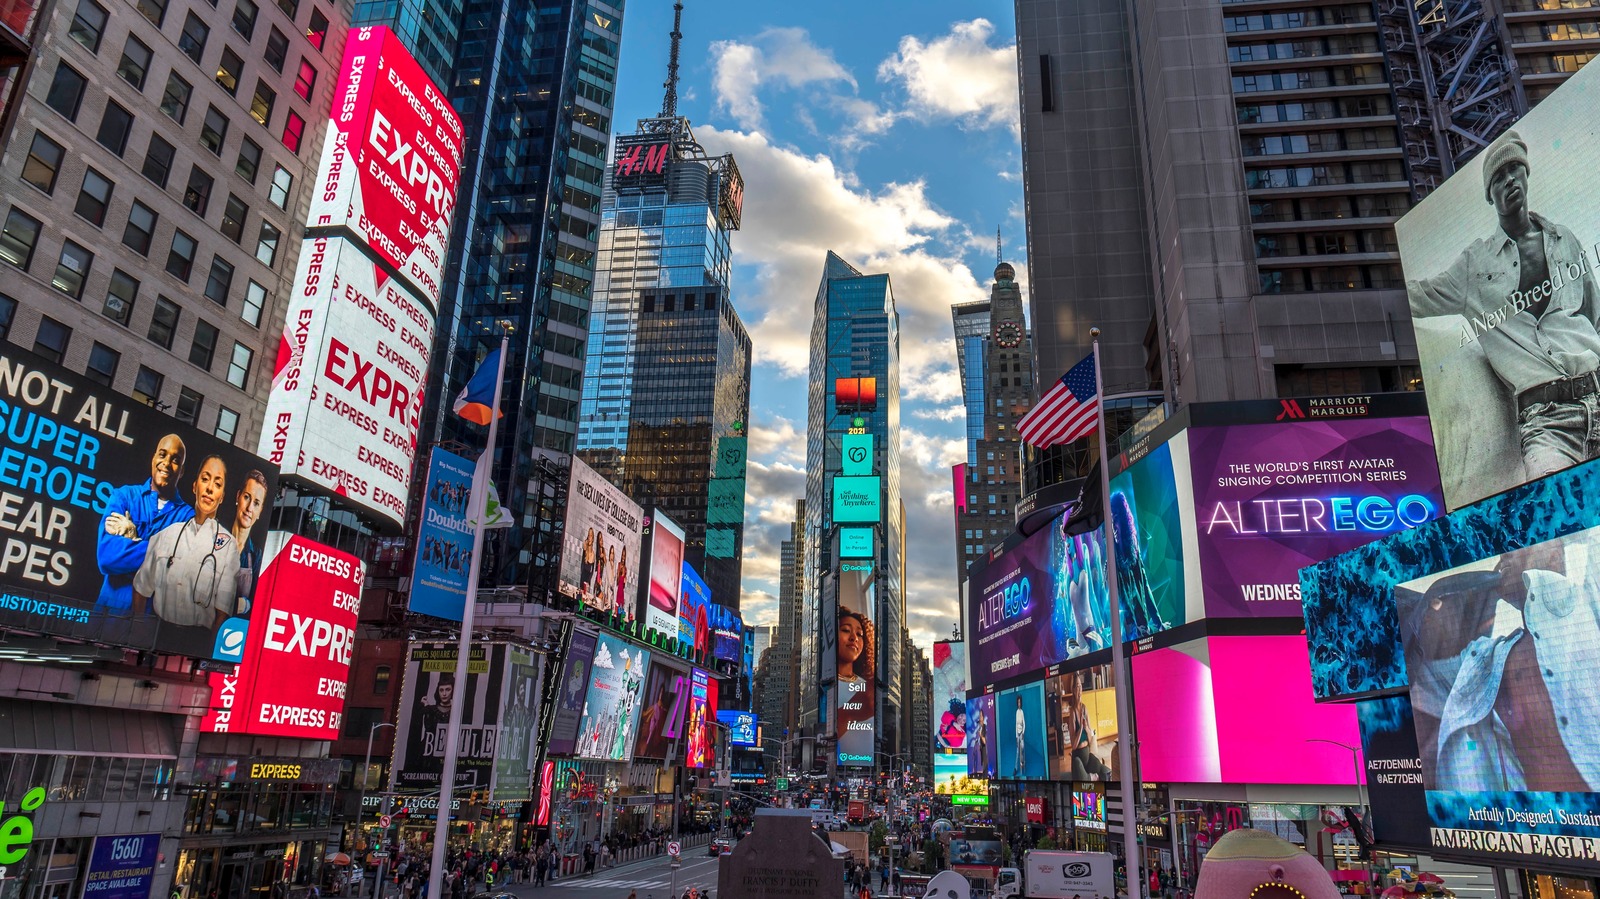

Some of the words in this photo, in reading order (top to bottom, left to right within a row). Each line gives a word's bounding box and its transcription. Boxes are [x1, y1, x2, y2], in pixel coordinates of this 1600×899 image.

[340, 55, 366, 122] EXPRESS
[388, 68, 432, 127] EXPRESS
[425, 84, 462, 139] EXPRESS
[323, 132, 349, 202] EXPRESS
[415, 130, 454, 183] EXPRESS
[616, 144, 669, 176] H&M
[369, 160, 417, 214] EXPRESS
[358, 214, 408, 266] EXPRESS
[398, 220, 440, 271] EXPRESS
[346, 284, 396, 332] EXPRESS
[386, 287, 428, 332] EXPRESS
[1458, 324, 1473, 348] A
[1472, 304, 1508, 338] New
[1510, 260, 1565, 316] Breed
[1567, 249, 1590, 282] of
[284, 309, 312, 392] EXPRESS
[376, 340, 420, 383] EXPRESS
[0, 354, 73, 414] NOT
[74, 395, 134, 444] ALL
[1309, 396, 1372, 406] MARRIOTT
[1310, 406, 1366, 416] MARQUIS
[324, 394, 378, 436] EXPRESS
[1128, 436, 1150, 454] MARRIOTT
[1128, 446, 1149, 464] MARQUIS
[312, 457, 368, 496] EXPRESS
[357, 446, 404, 483] EXPRESS
[1218, 475, 1272, 487] SINGING
[1275, 472, 1362, 485] COMPETITION
[1366, 470, 1407, 482] SERIES
[1229, 463, 1251, 474] THE
[1254, 461, 1310, 473] WORLD'S
[1313, 460, 1344, 471] FIRST
[1348, 458, 1395, 469] AVATAR
[576, 480, 584, 496] THE
[584, 482, 594, 502] SEX
[593, 488, 606, 510] LIVES
[605, 498, 612, 514] OF
[610, 502, 628, 526] COLLEGE
[627, 514, 638, 534] GIRLS
[842, 500, 876, 508] Anywhere.
[289, 544, 351, 579] EXPRESS
[1138, 636, 1154, 645] MARRIOTT
[1139, 644, 1153, 652] MARQUIS
[413, 650, 429, 659] TIMES
[430, 650, 450, 660] SQUARE
[424, 662, 442, 670] MAKE
[848, 682, 866, 692] Sell
[260, 704, 326, 728] EXPRESS
[842, 702, 862, 710] new
[846, 720, 874, 732] ideas.
[250, 763, 301, 780] EXPRESS
[848, 754, 873, 762] GoDaddy
[1468, 806, 1504, 826] Artfully
[1506, 808, 1558, 828] Designed.
[111, 838, 140, 860] 1560
[1432, 828, 1526, 854] AMERICAN
[1528, 834, 1597, 860] EAGLE
[86, 880, 107, 892] SPACE
[108, 877, 142, 889] AVAILABLE
[742, 876, 780, 886] FRANCIS
[789, 878, 820, 888] DUFFY
